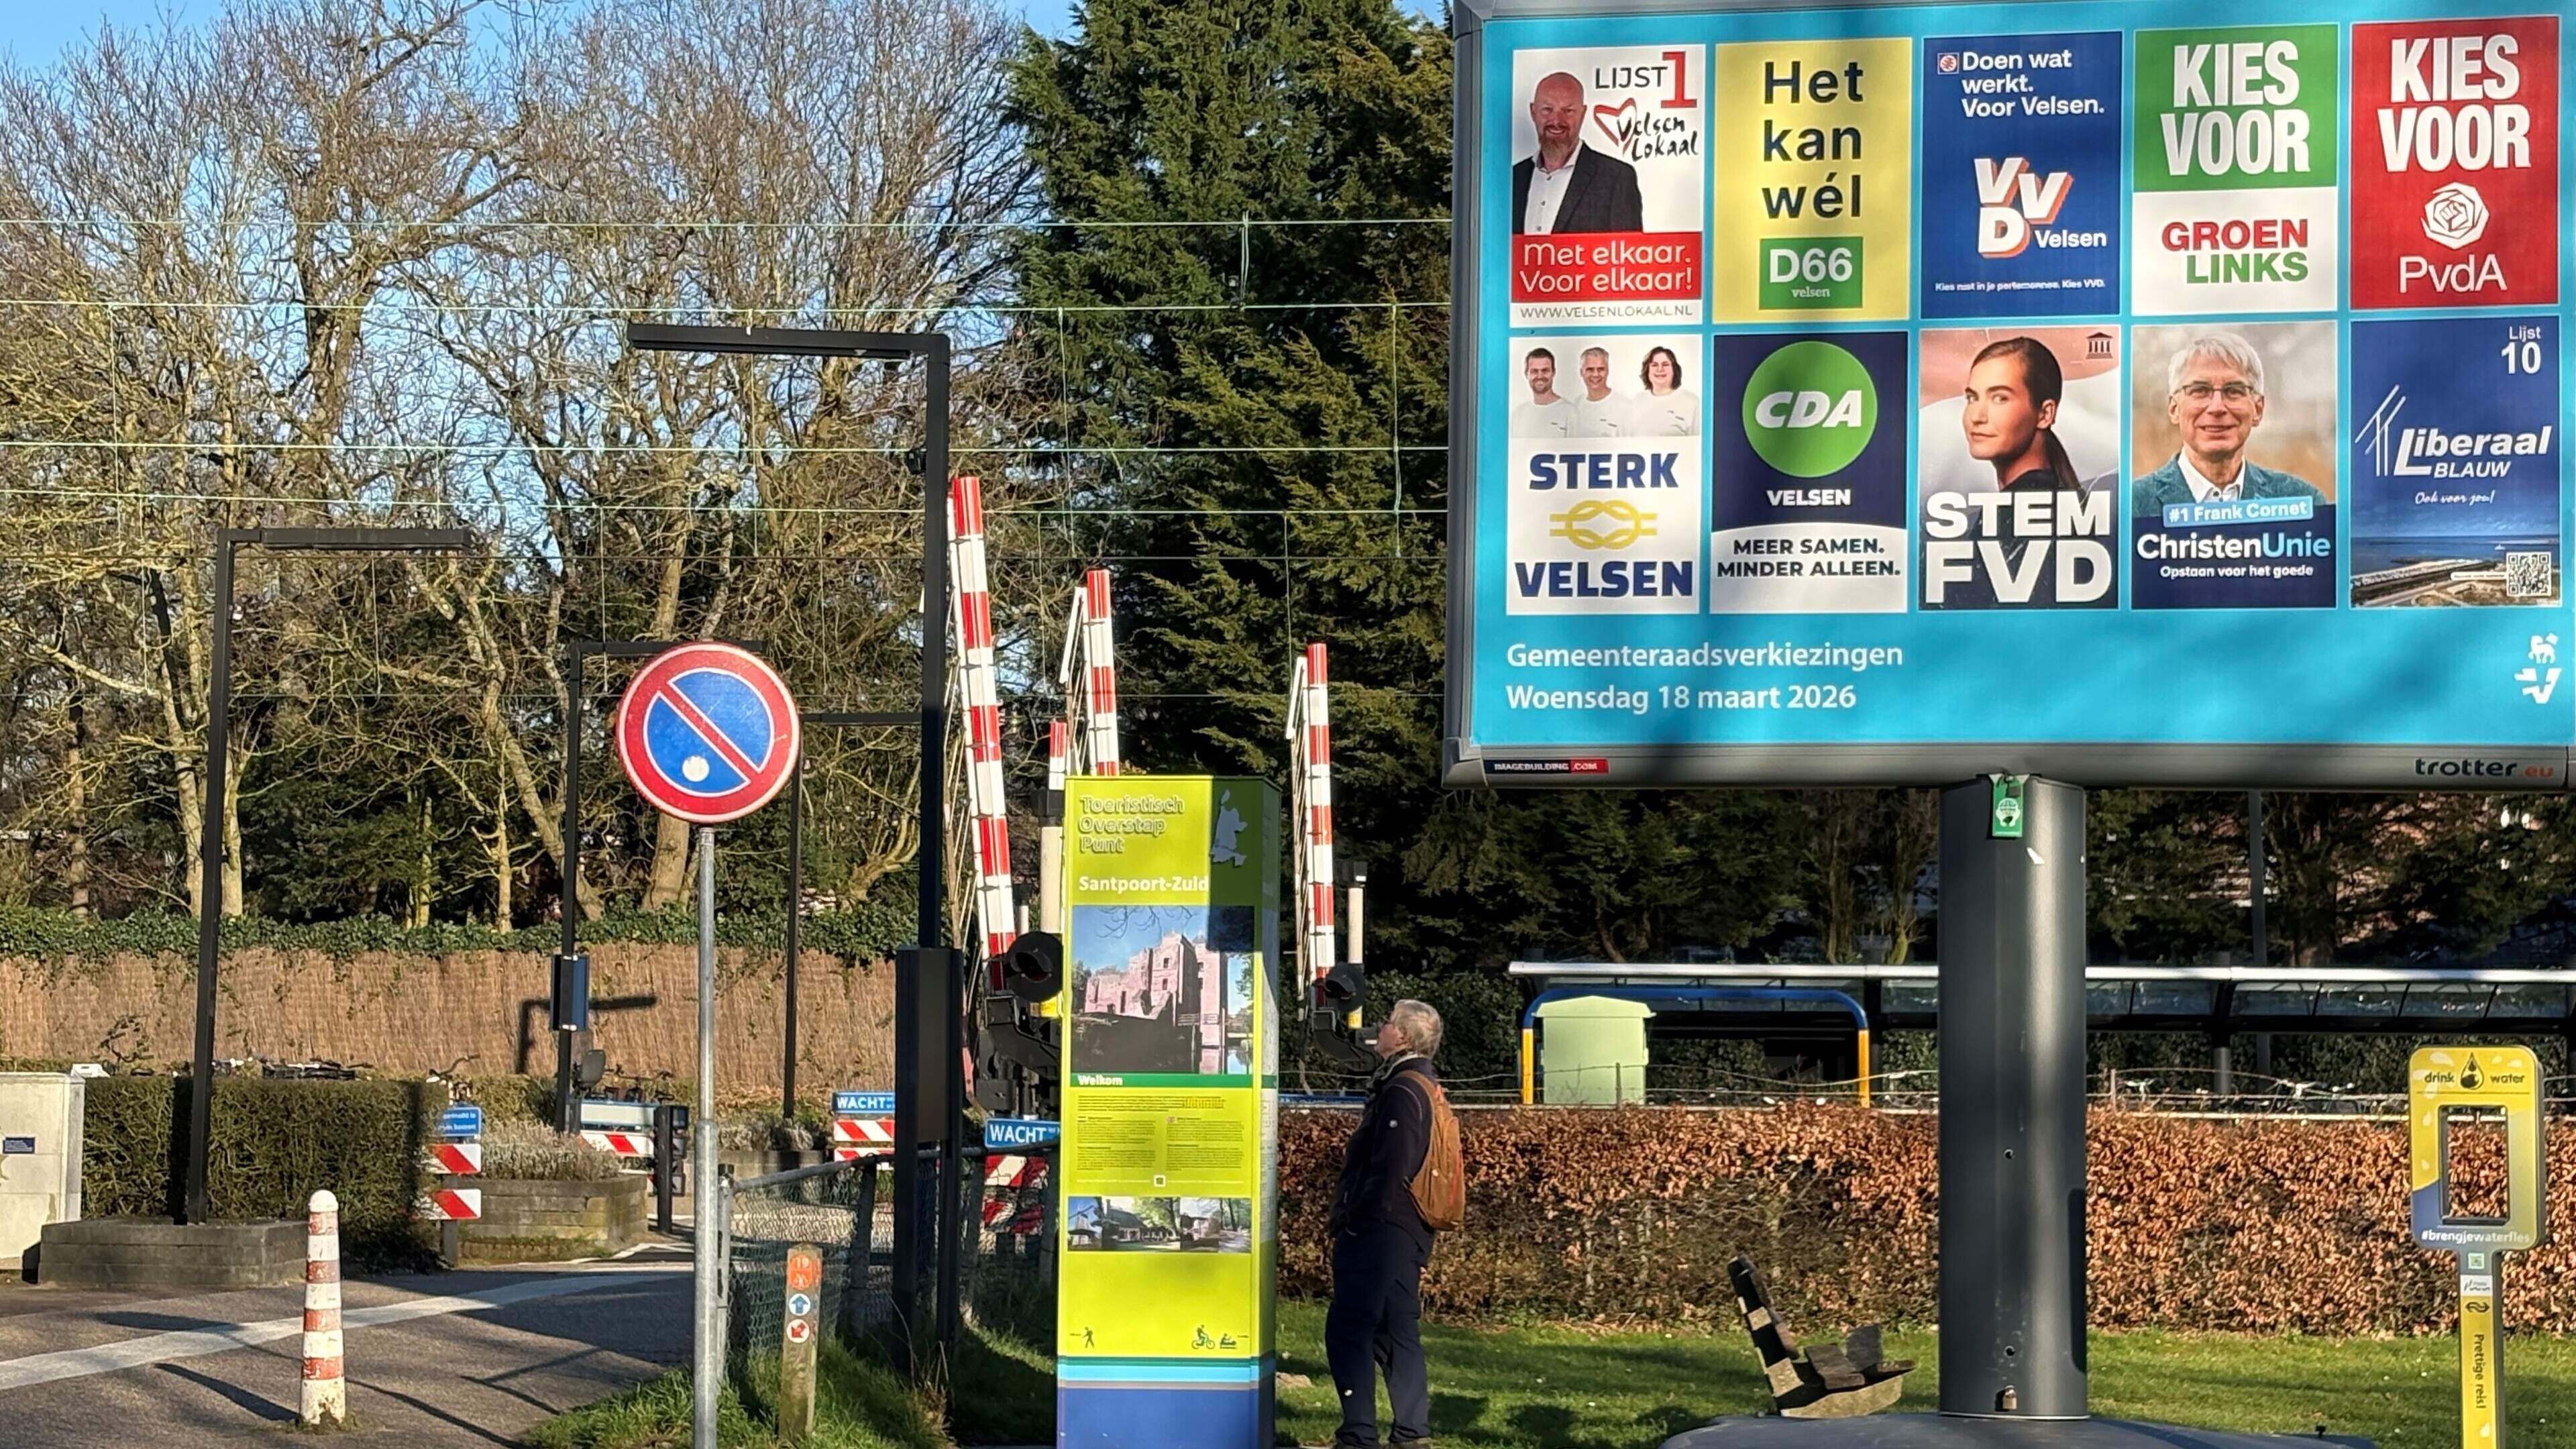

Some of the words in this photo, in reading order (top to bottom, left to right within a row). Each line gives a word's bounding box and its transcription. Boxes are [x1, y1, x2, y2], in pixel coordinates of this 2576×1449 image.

[1962, 52, 2023, 70] Doen
[2028, 50, 2072, 68] wat
[2390, 34, 2520, 103] KIES
[1595, 66, 1668, 89] LIJST
[1660, 51, 1697, 109] 1
[1764, 62, 1863, 104] Het
[1962, 74, 2034, 94] werkt.
[2172, 40, 2300, 107] KIES
[1962, 99, 2015, 117] Voor
[2021, 96, 2105, 116] Velsen.
[1617, 112, 1685, 142] Velsen
[2377, 103, 2532, 172] VOOR
[1631, 130, 1699, 162] Lokaal
[1764, 120, 1861, 162] kan
[2159, 108, 2310, 176] VOOR
[1762, 173, 1861, 219] wél
[2035, 230, 2107, 248] Velsen
[2161, 219, 2308, 251] GROEN
[1524, 243, 1585, 266] Met
[1593, 240, 1691, 266] elkaar.
[1769, 248, 1853, 283] D66
[1519, 270, 1586, 292] Voor
[1592, 267, 1692, 292] elkaar!
[2186, 252, 2308, 284] LINKS
[2398, 254, 2508, 293] PvdA
[1792, 286, 1830, 299] velsen
[1935, 282, 1955, 291] Kies
[1976, 282, 1985, 290] in
[2061, 279, 2081, 288] Kies
[2084, 278, 2106, 288] VVD.
[1520, 305, 1693, 318] WWW.VELSENLOKAAL.NL
[2509, 325, 2541, 342] Lijst
[2501, 341, 2541, 374] 10
[1754, 390, 1863, 428] CDA
[2393, 426, 2552, 476] Liberaal
[1528, 453, 1678, 490] STERK
[2434, 461, 2511, 478] BLAUW
[1766, 489, 1851, 506] VELSEN
[2415, 491, 2438, 504] Ook
[2440, 494, 2467, 503] voor
[1926, 492, 2110, 538] STEM
[2169, 507, 2189, 523] #1
[2193, 506, 2243, 522] Frank
[2247, 501, 2308, 518] Cornet
[1733, 539, 1794, 555] MEER
[1800, 538, 1885, 555] SAMEN.
[2137, 531, 2331, 559] ChristenUnie
[1514, 561, 1693, 597] VELSEN
[1717, 561, 1803, 578] MINDER
[1809, 560, 1900, 577] ALLEEN.
[1926, 540, 2112, 604] FVD
[2160, 566, 2214, 580] Opstaan
[2217, 566, 2247, 577] voor
[2249, 565, 2271, 577] het
[1507, 642, 1903, 672] Gemeenteraadsverkiezingen
[1507, 685, 1649, 714] Woensdag
[1660, 686, 1690, 708] 18
[1698, 686, 1780, 708] maart
[1788, 686, 1856, 708] 2026
[1079, 794, 1185, 814] Toeristisch
[1078, 816, 1166, 837] Overstap
[1079, 837, 1124, 853] Punt
[1079, 875, 1209, 894] Santpoort-Zuid
[1078, 1075, 1123, 1085] Welkom
[2424, 1072, 2455, 1083] drink
[2489, 1074, 2525, 1083] water
[837, 1097, 885, 1109] WACHT
[989, 1124, 1046, 1143] WACHT
[2421, 1229, 2530, 1244] #brengjewaterfles
[2472, 1334, 2486, 1380] Prettige
[2475, 1384, 2487, 1409] reis!
